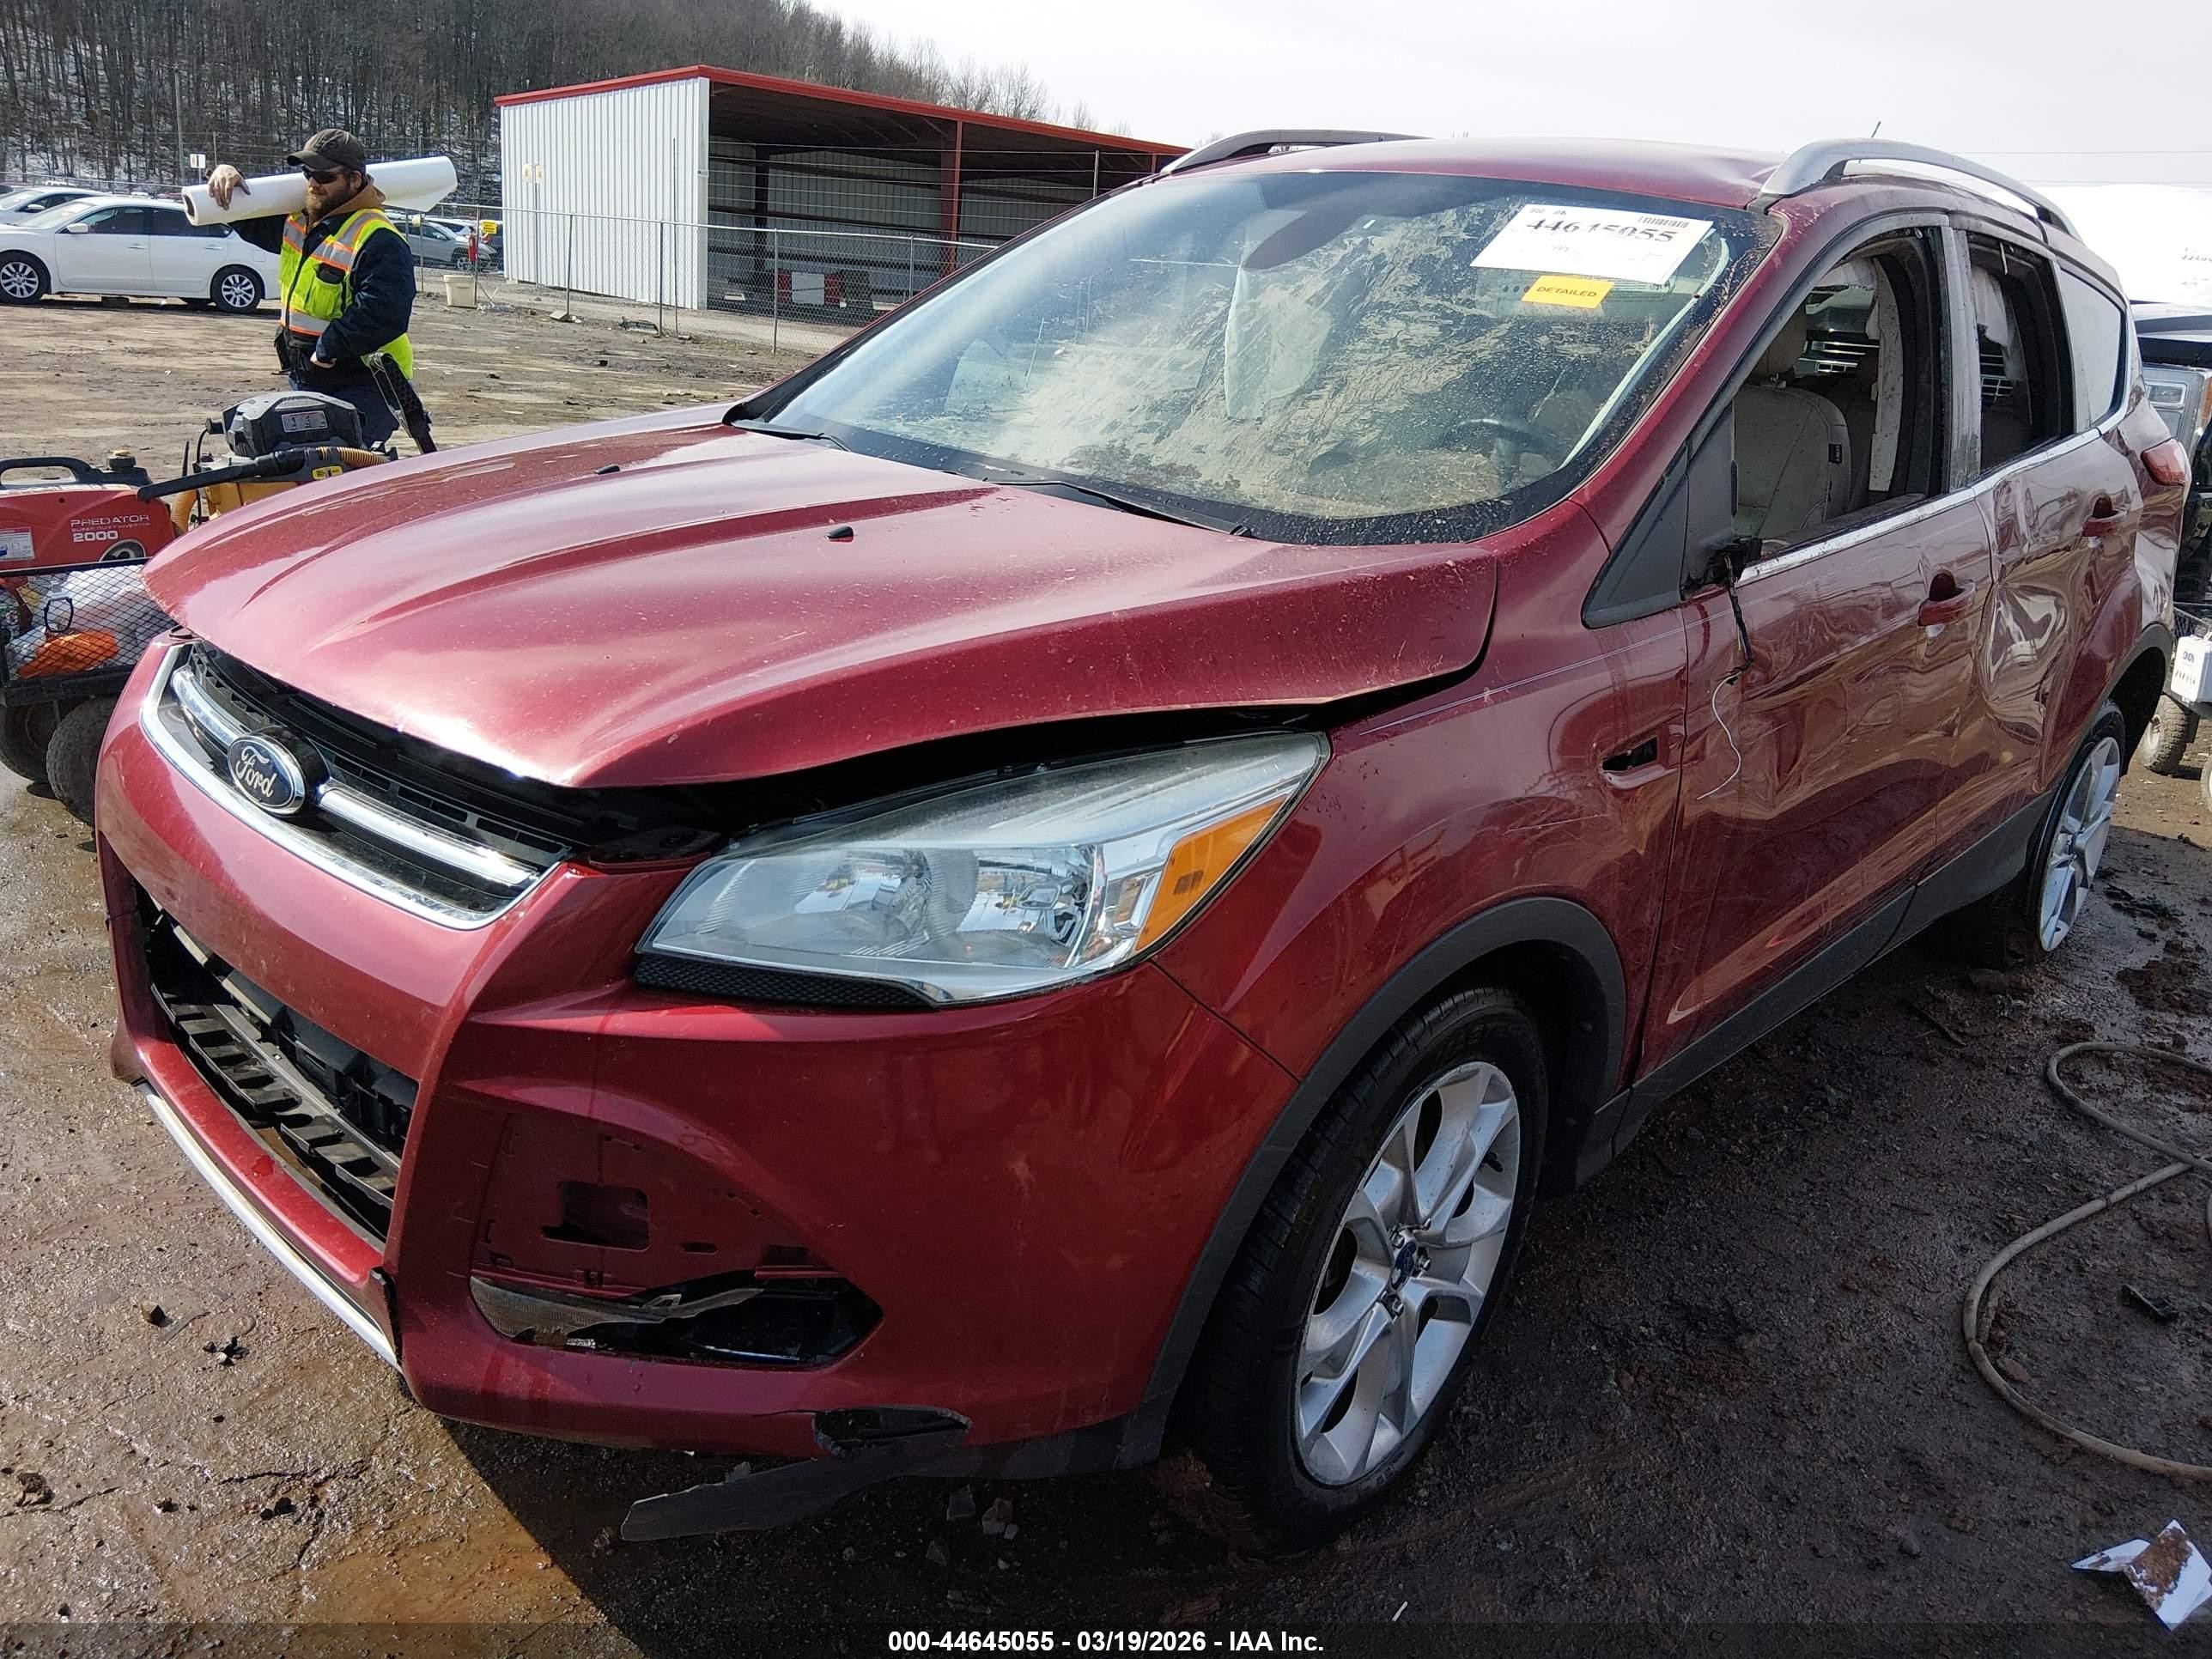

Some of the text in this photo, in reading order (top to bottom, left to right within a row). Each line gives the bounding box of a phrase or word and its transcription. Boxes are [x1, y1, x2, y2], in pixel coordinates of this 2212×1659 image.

[1536, 286, 1597, 297] DETAILED
[70, 514, 150, 527] PREDATOR
[72, 530, 118, 543] 2000
[235, 745, 278, 798] Ford
